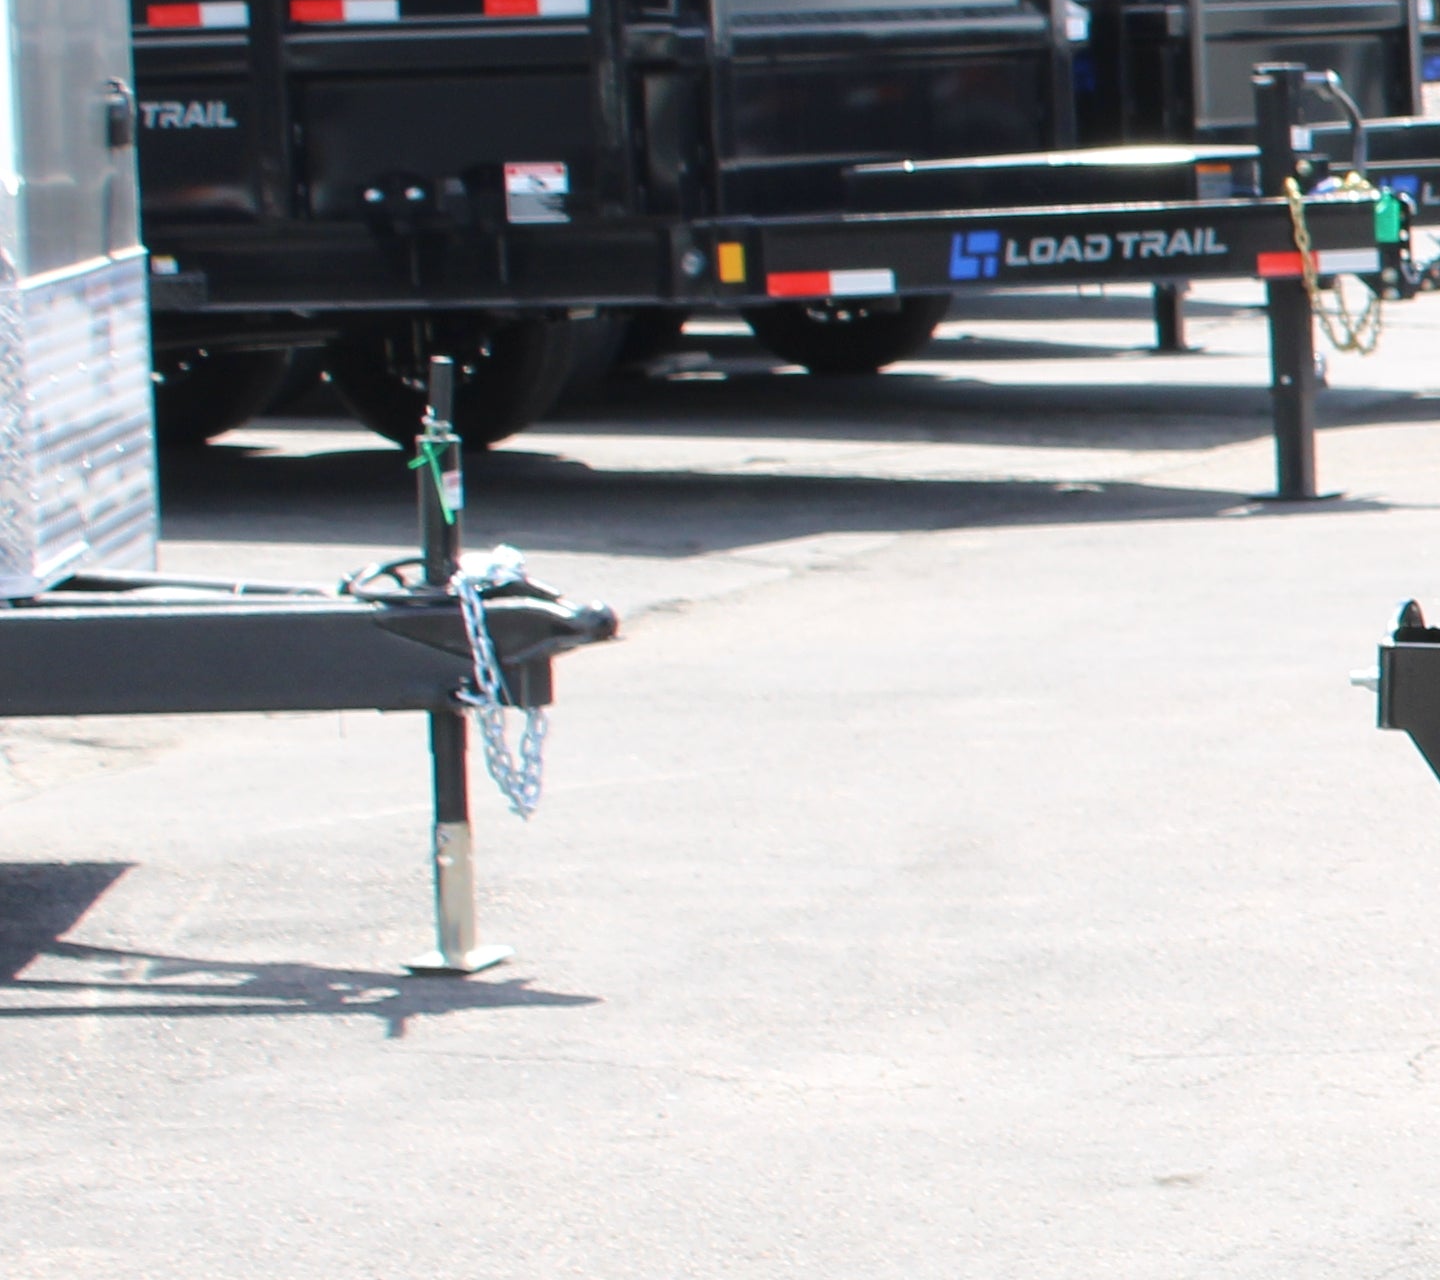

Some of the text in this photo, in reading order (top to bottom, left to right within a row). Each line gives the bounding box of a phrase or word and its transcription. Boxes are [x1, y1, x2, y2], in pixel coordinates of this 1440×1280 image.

[140, 100, 238, 129] TRAIL
[1005, 226, 1228, 267] LOAD TRAIL
